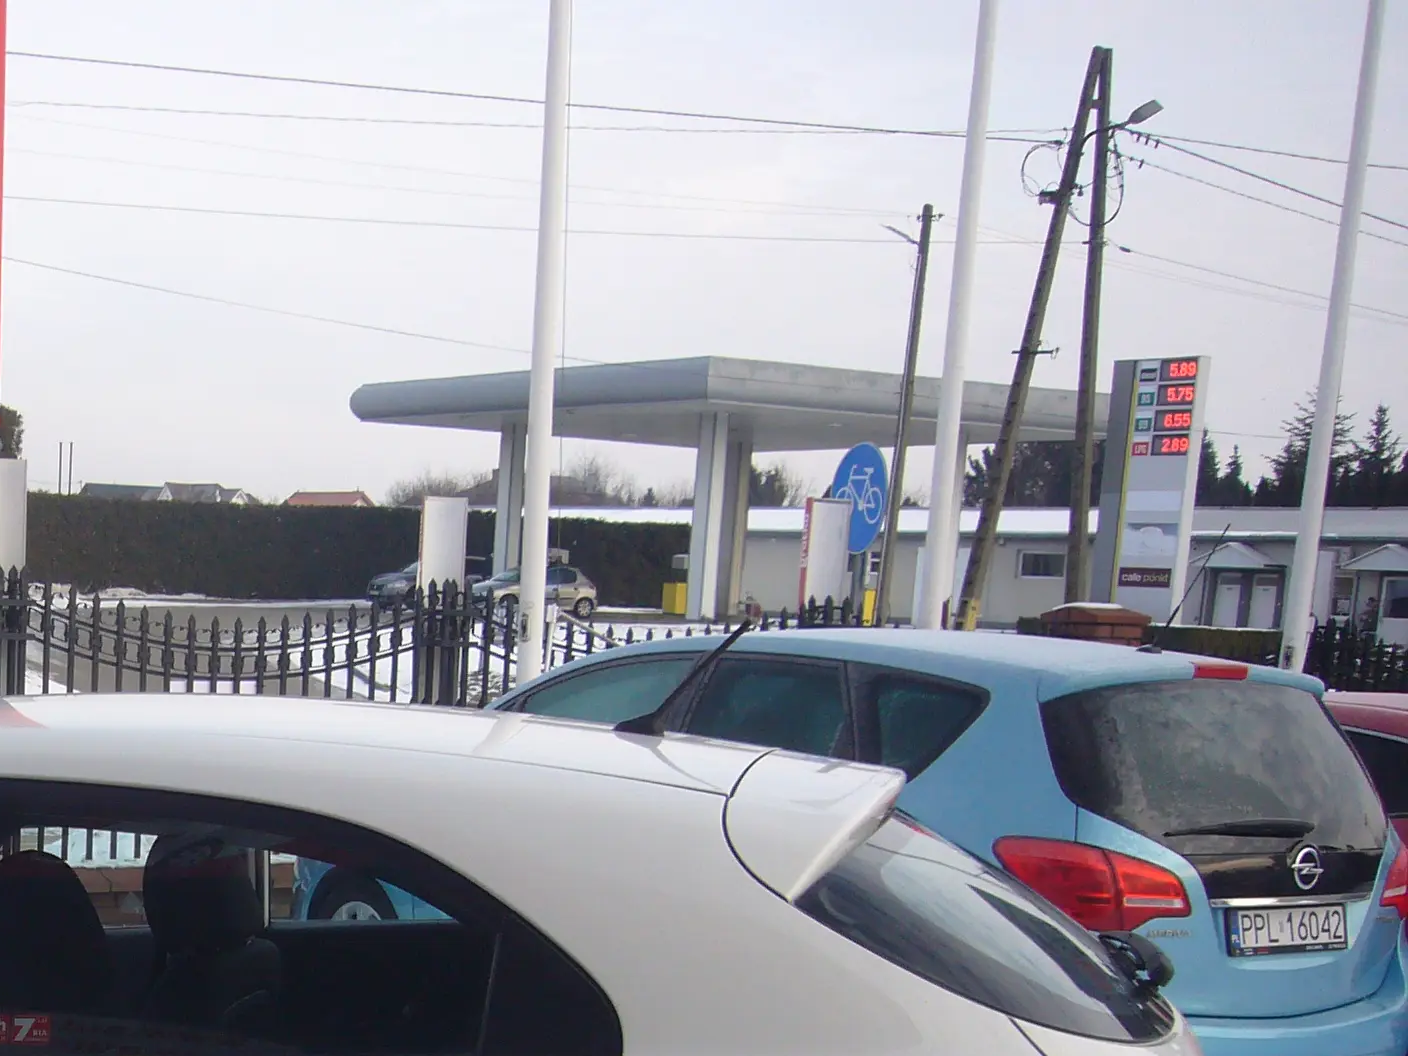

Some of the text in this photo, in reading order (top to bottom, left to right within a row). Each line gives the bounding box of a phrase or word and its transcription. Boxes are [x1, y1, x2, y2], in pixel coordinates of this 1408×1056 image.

[1240, 912, 1280, 945] PPL
[1286, 910, 1344, 942] 16042
[14, 1018, 36, 1042] 7
